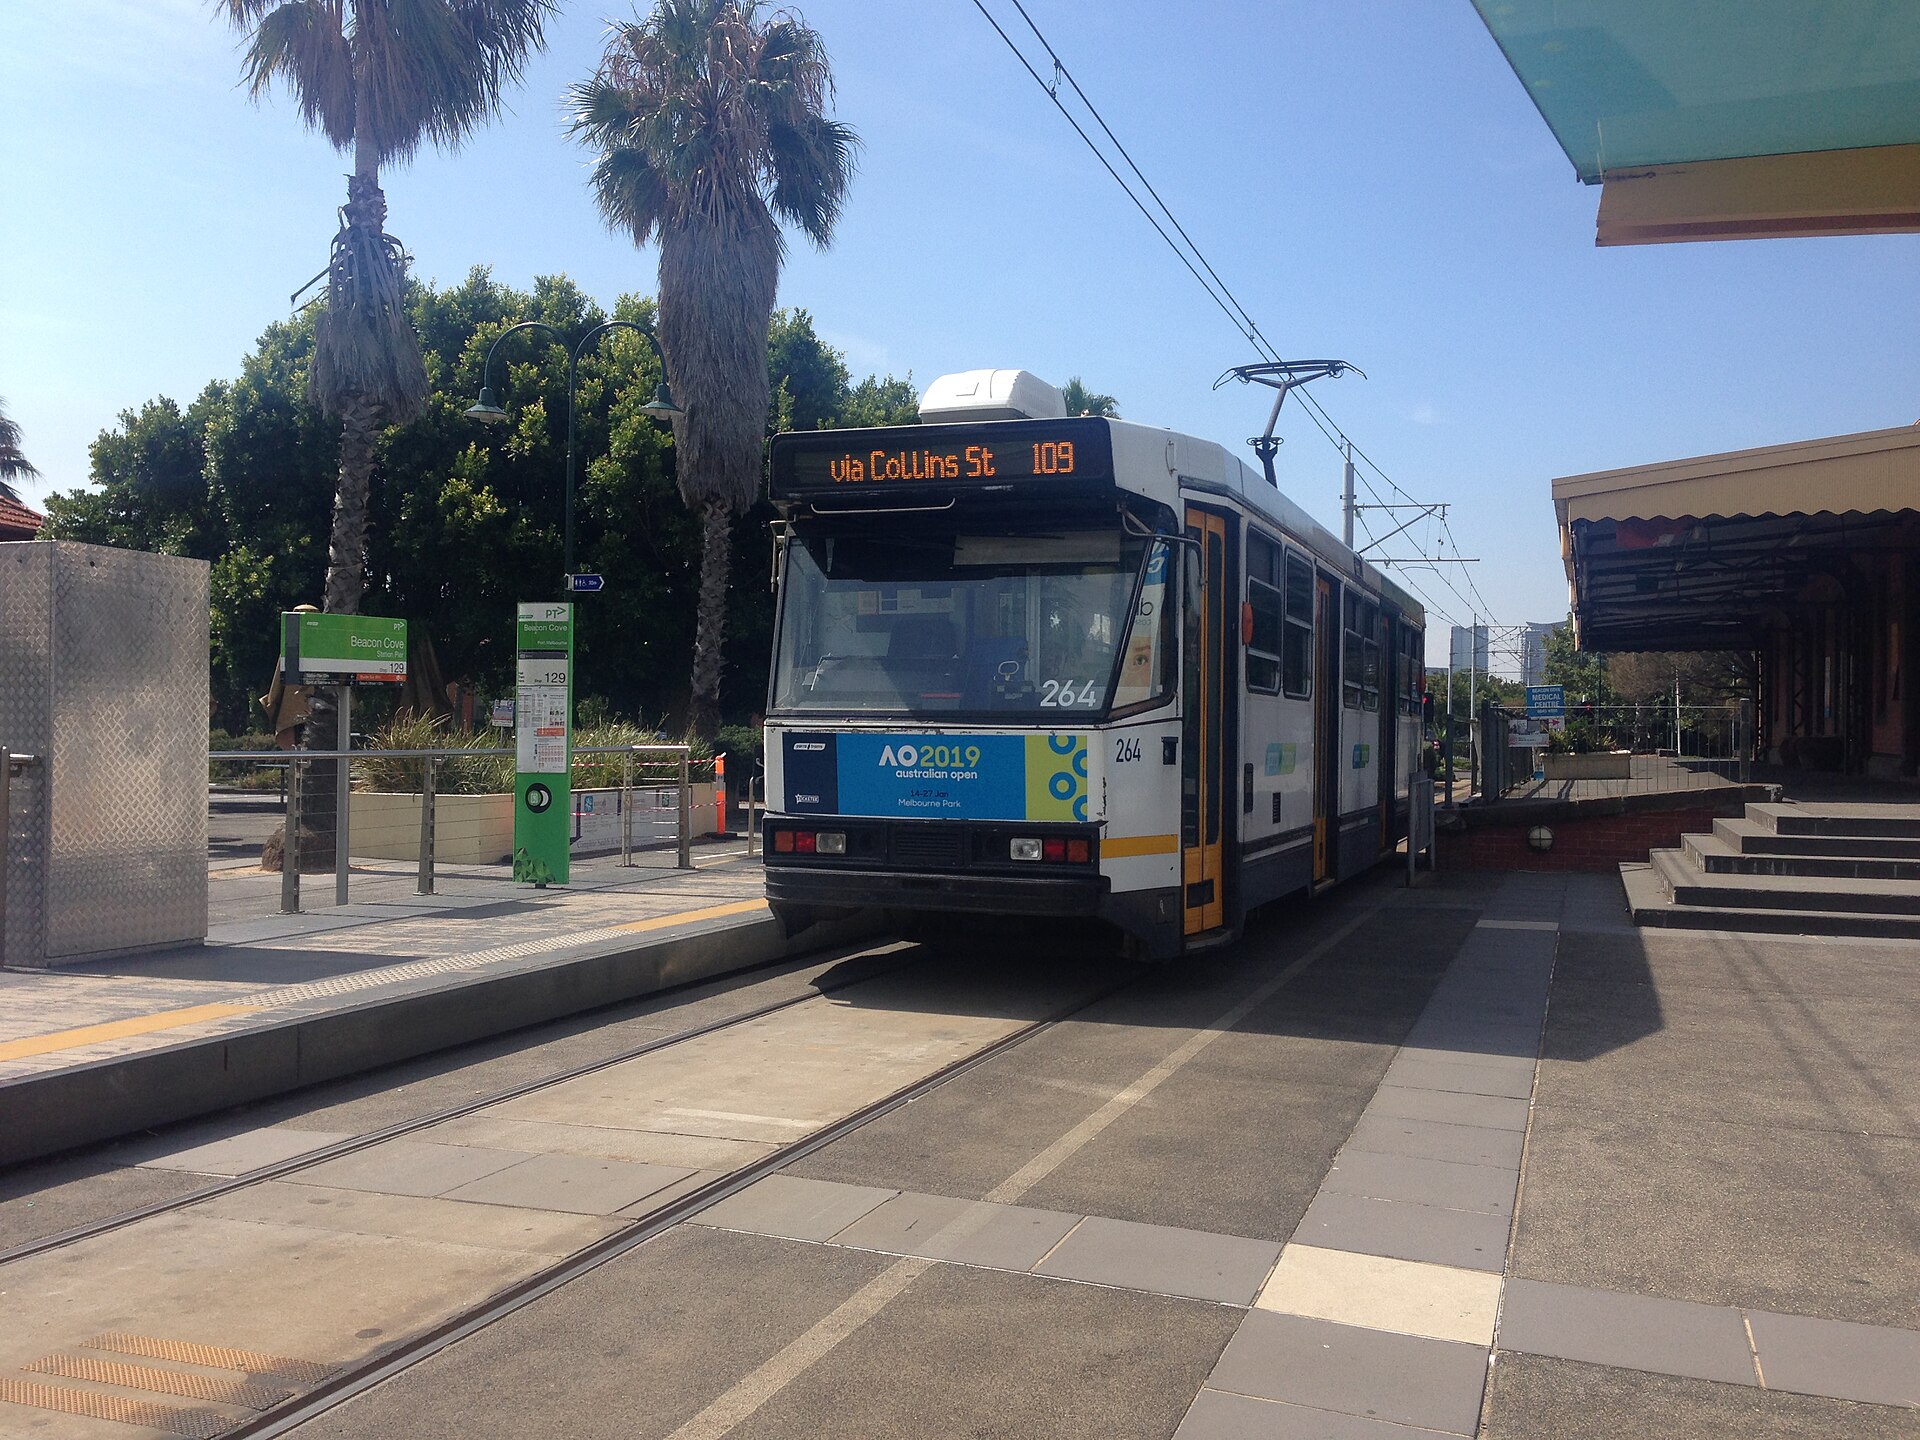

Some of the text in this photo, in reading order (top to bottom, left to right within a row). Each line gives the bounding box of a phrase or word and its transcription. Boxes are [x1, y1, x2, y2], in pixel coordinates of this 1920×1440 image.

[830, 440, 1074, 483] via Collins St 109
[524, 624, 568, 632] Beacon Cove
[351, 635, 404, 649] Beacon Cove
[377, 650, 394, 658] Station
[390, 662, 404, 673] 129
[544, 672, 566, 684] 129
[1039, 679, 1097, 708] 264
[1116, 738, 1142, 763] 264
[895, 768, 978, 781] australian open
[910, 789, 949, 798] 14-27 Jan
[898, 799, 961, 808] Melbourne Park
